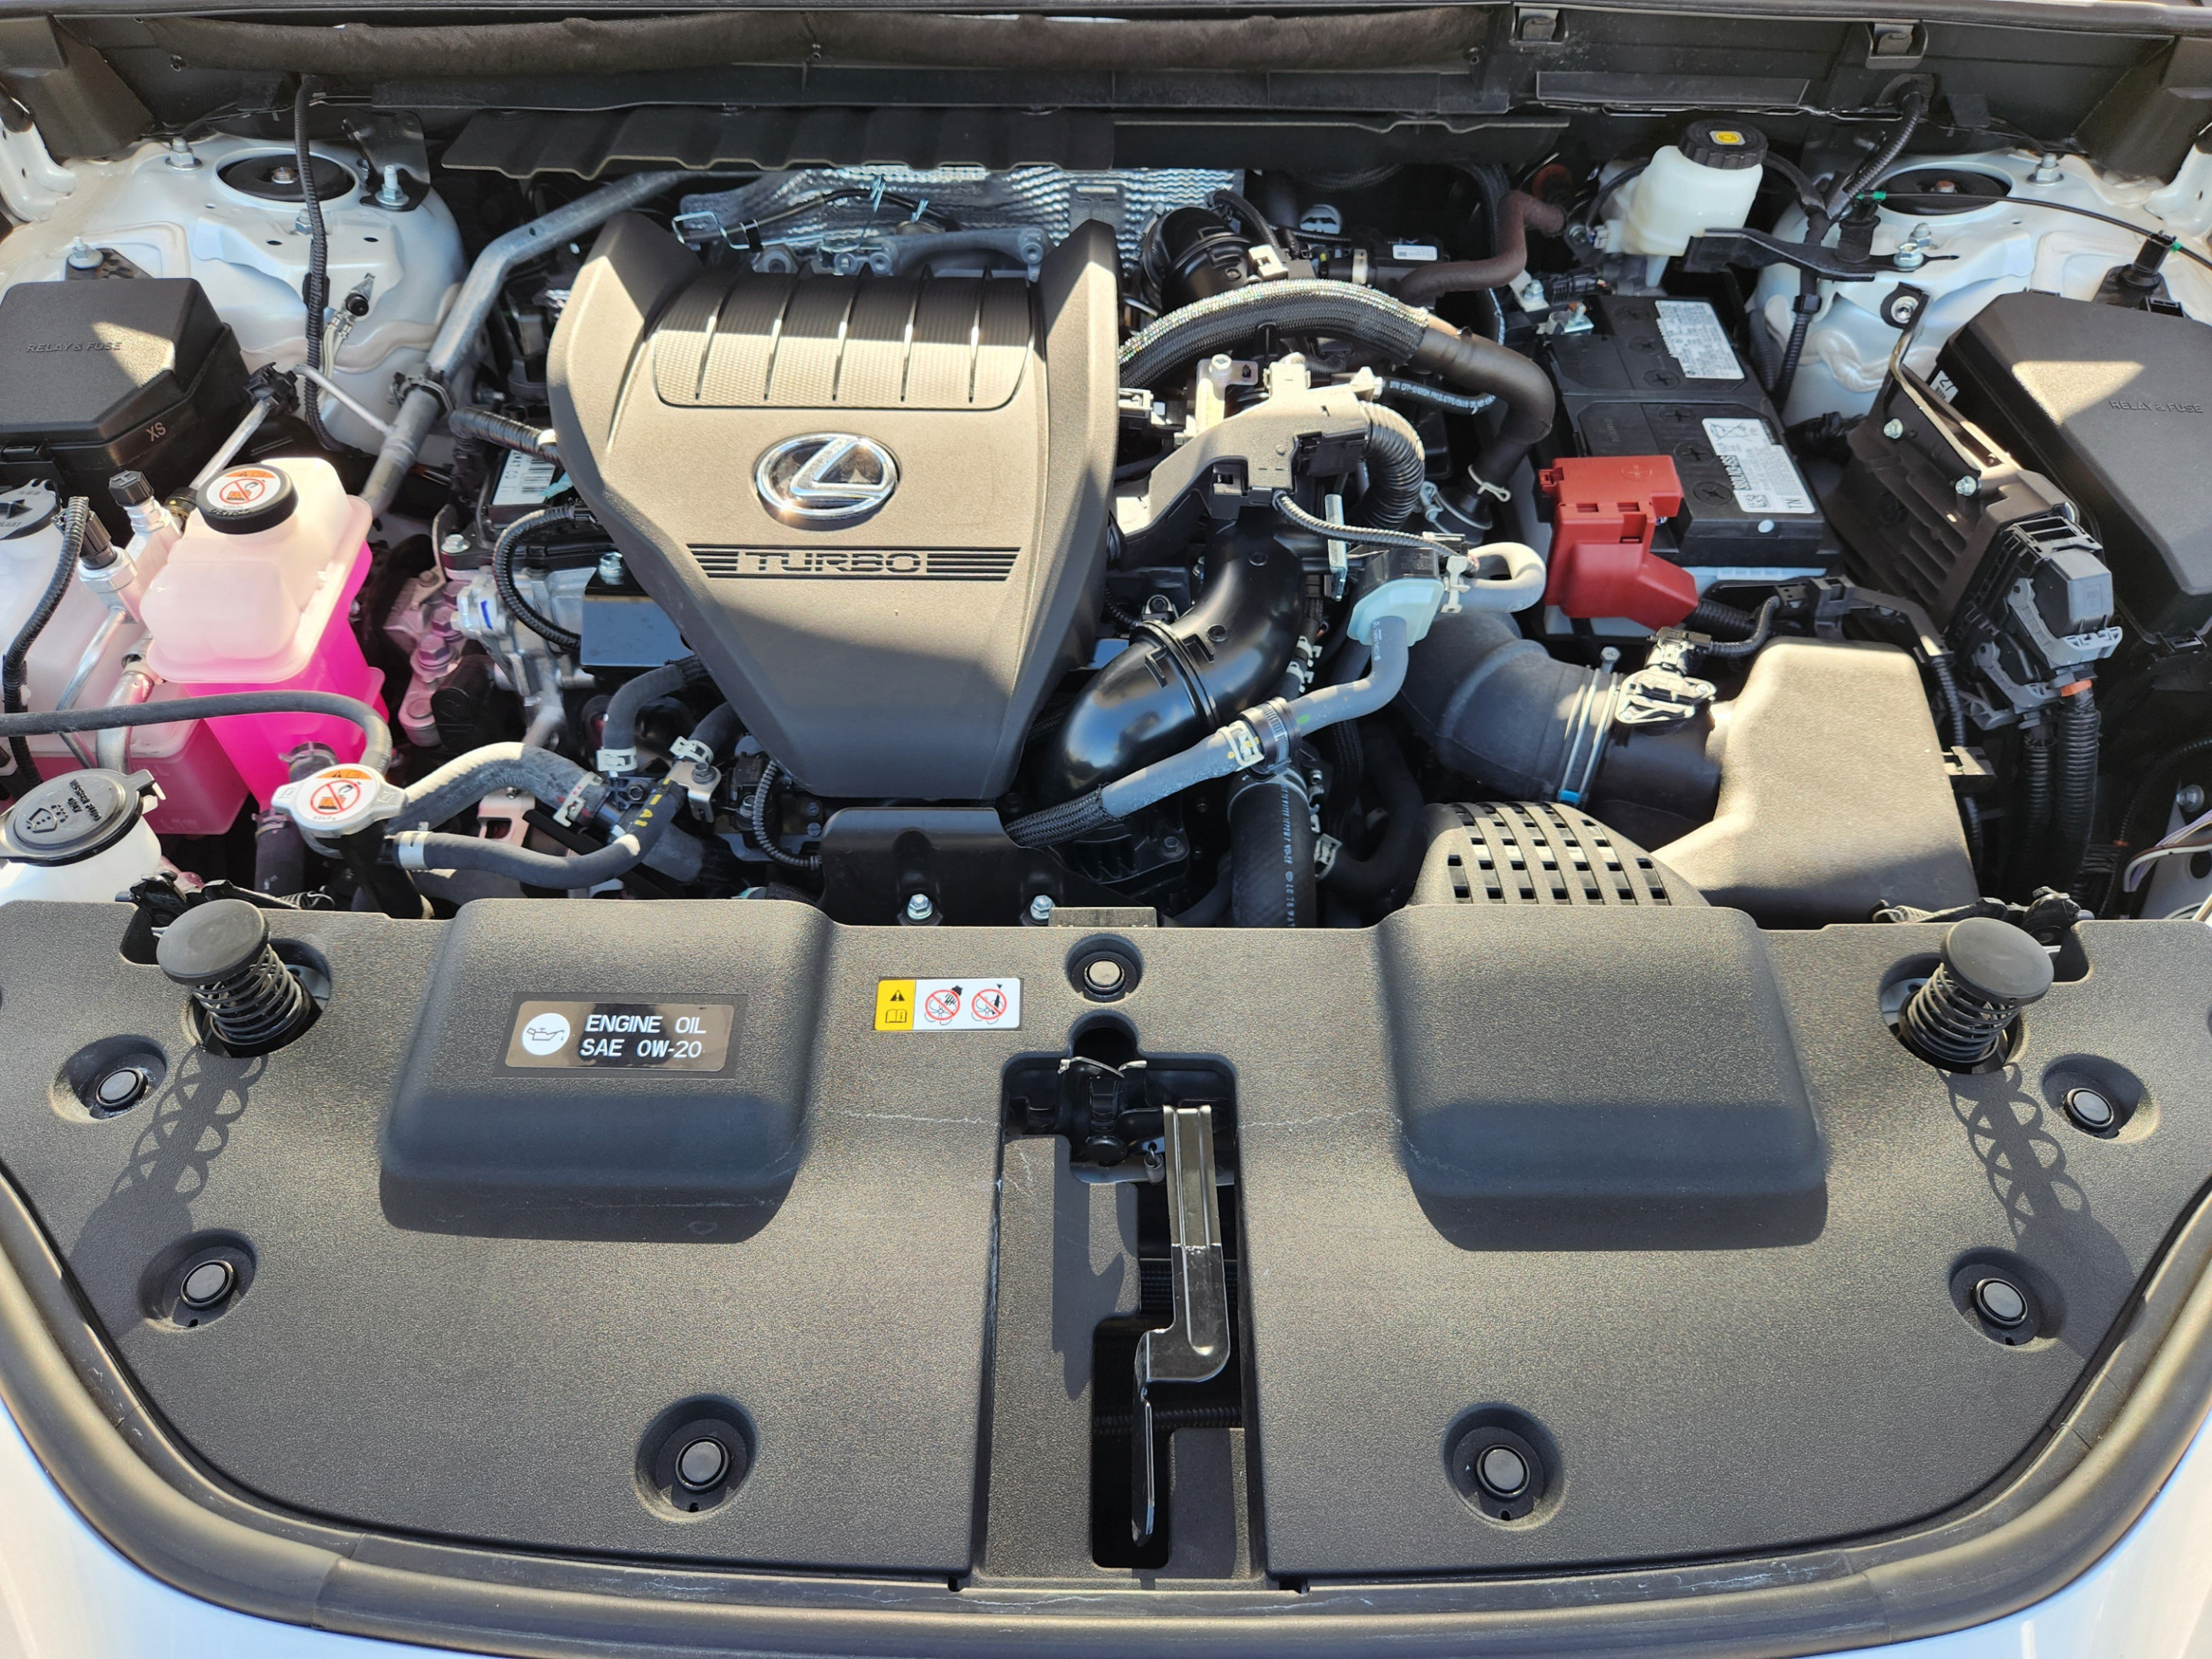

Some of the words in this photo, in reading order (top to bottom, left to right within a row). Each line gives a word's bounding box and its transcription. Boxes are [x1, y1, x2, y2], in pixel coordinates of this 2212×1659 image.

[26, 343, 72, 353] RELAY
[86, 341, 123, 351] FUSE
[2108, 400, 2152, 411] RELAY
[2155, 403, 2166, 412] &
[2166, 403, 2204, 413] FUSE
[146, 422, 167, 442] XS
[744, 551, 921, 574] TURBO
[69, 779, 91, 804] WASHER
[584, 1014, 663, 1033] ENGINE
[674, 1016, 707, 1035] OIL
[579, 1038, 625, 1057] SAE
[636, 1039, 703, 1058] 0W-20
